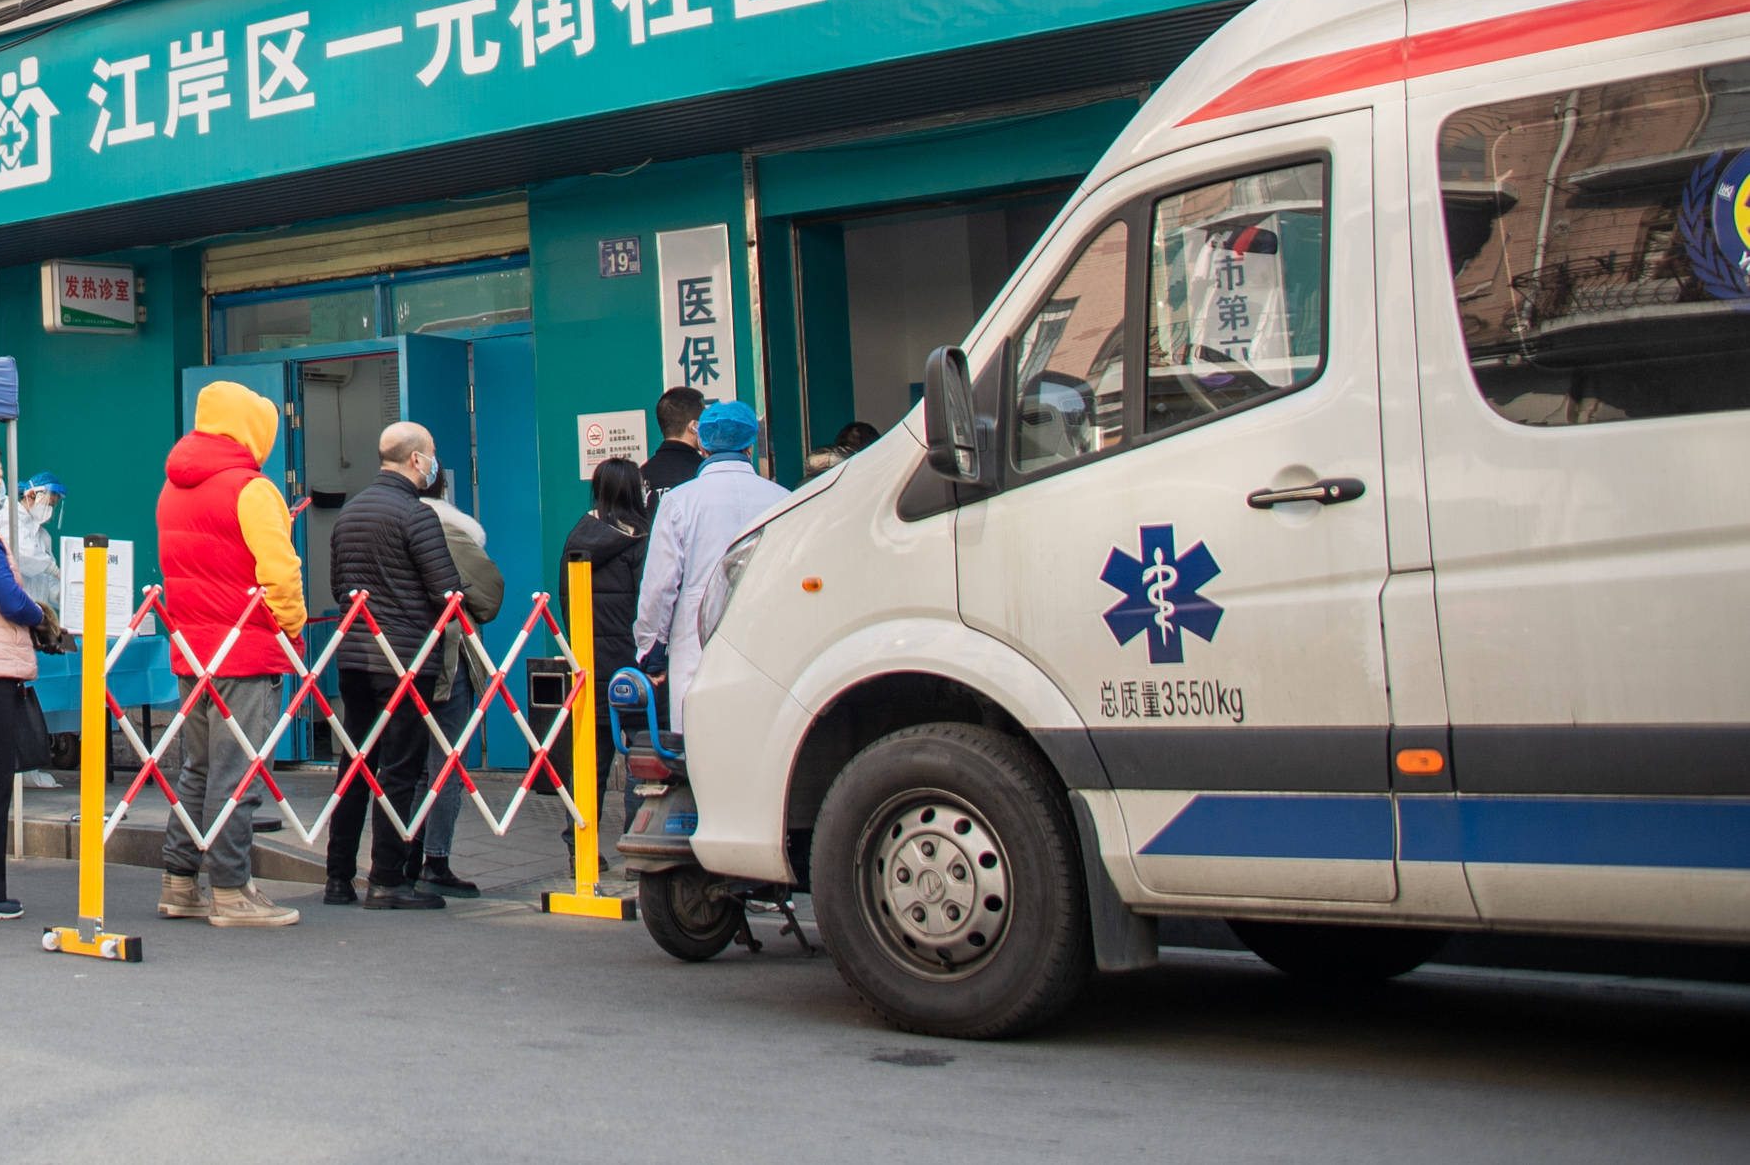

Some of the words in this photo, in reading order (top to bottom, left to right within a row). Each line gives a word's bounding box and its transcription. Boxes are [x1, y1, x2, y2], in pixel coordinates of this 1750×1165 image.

[65, 275, 130, 301] 发热诊室
[678, 276, 720, 404] 医保
[72, 552, 119, 565] 核测
[1100, 678, 1244, 723] 总质量3550kg
